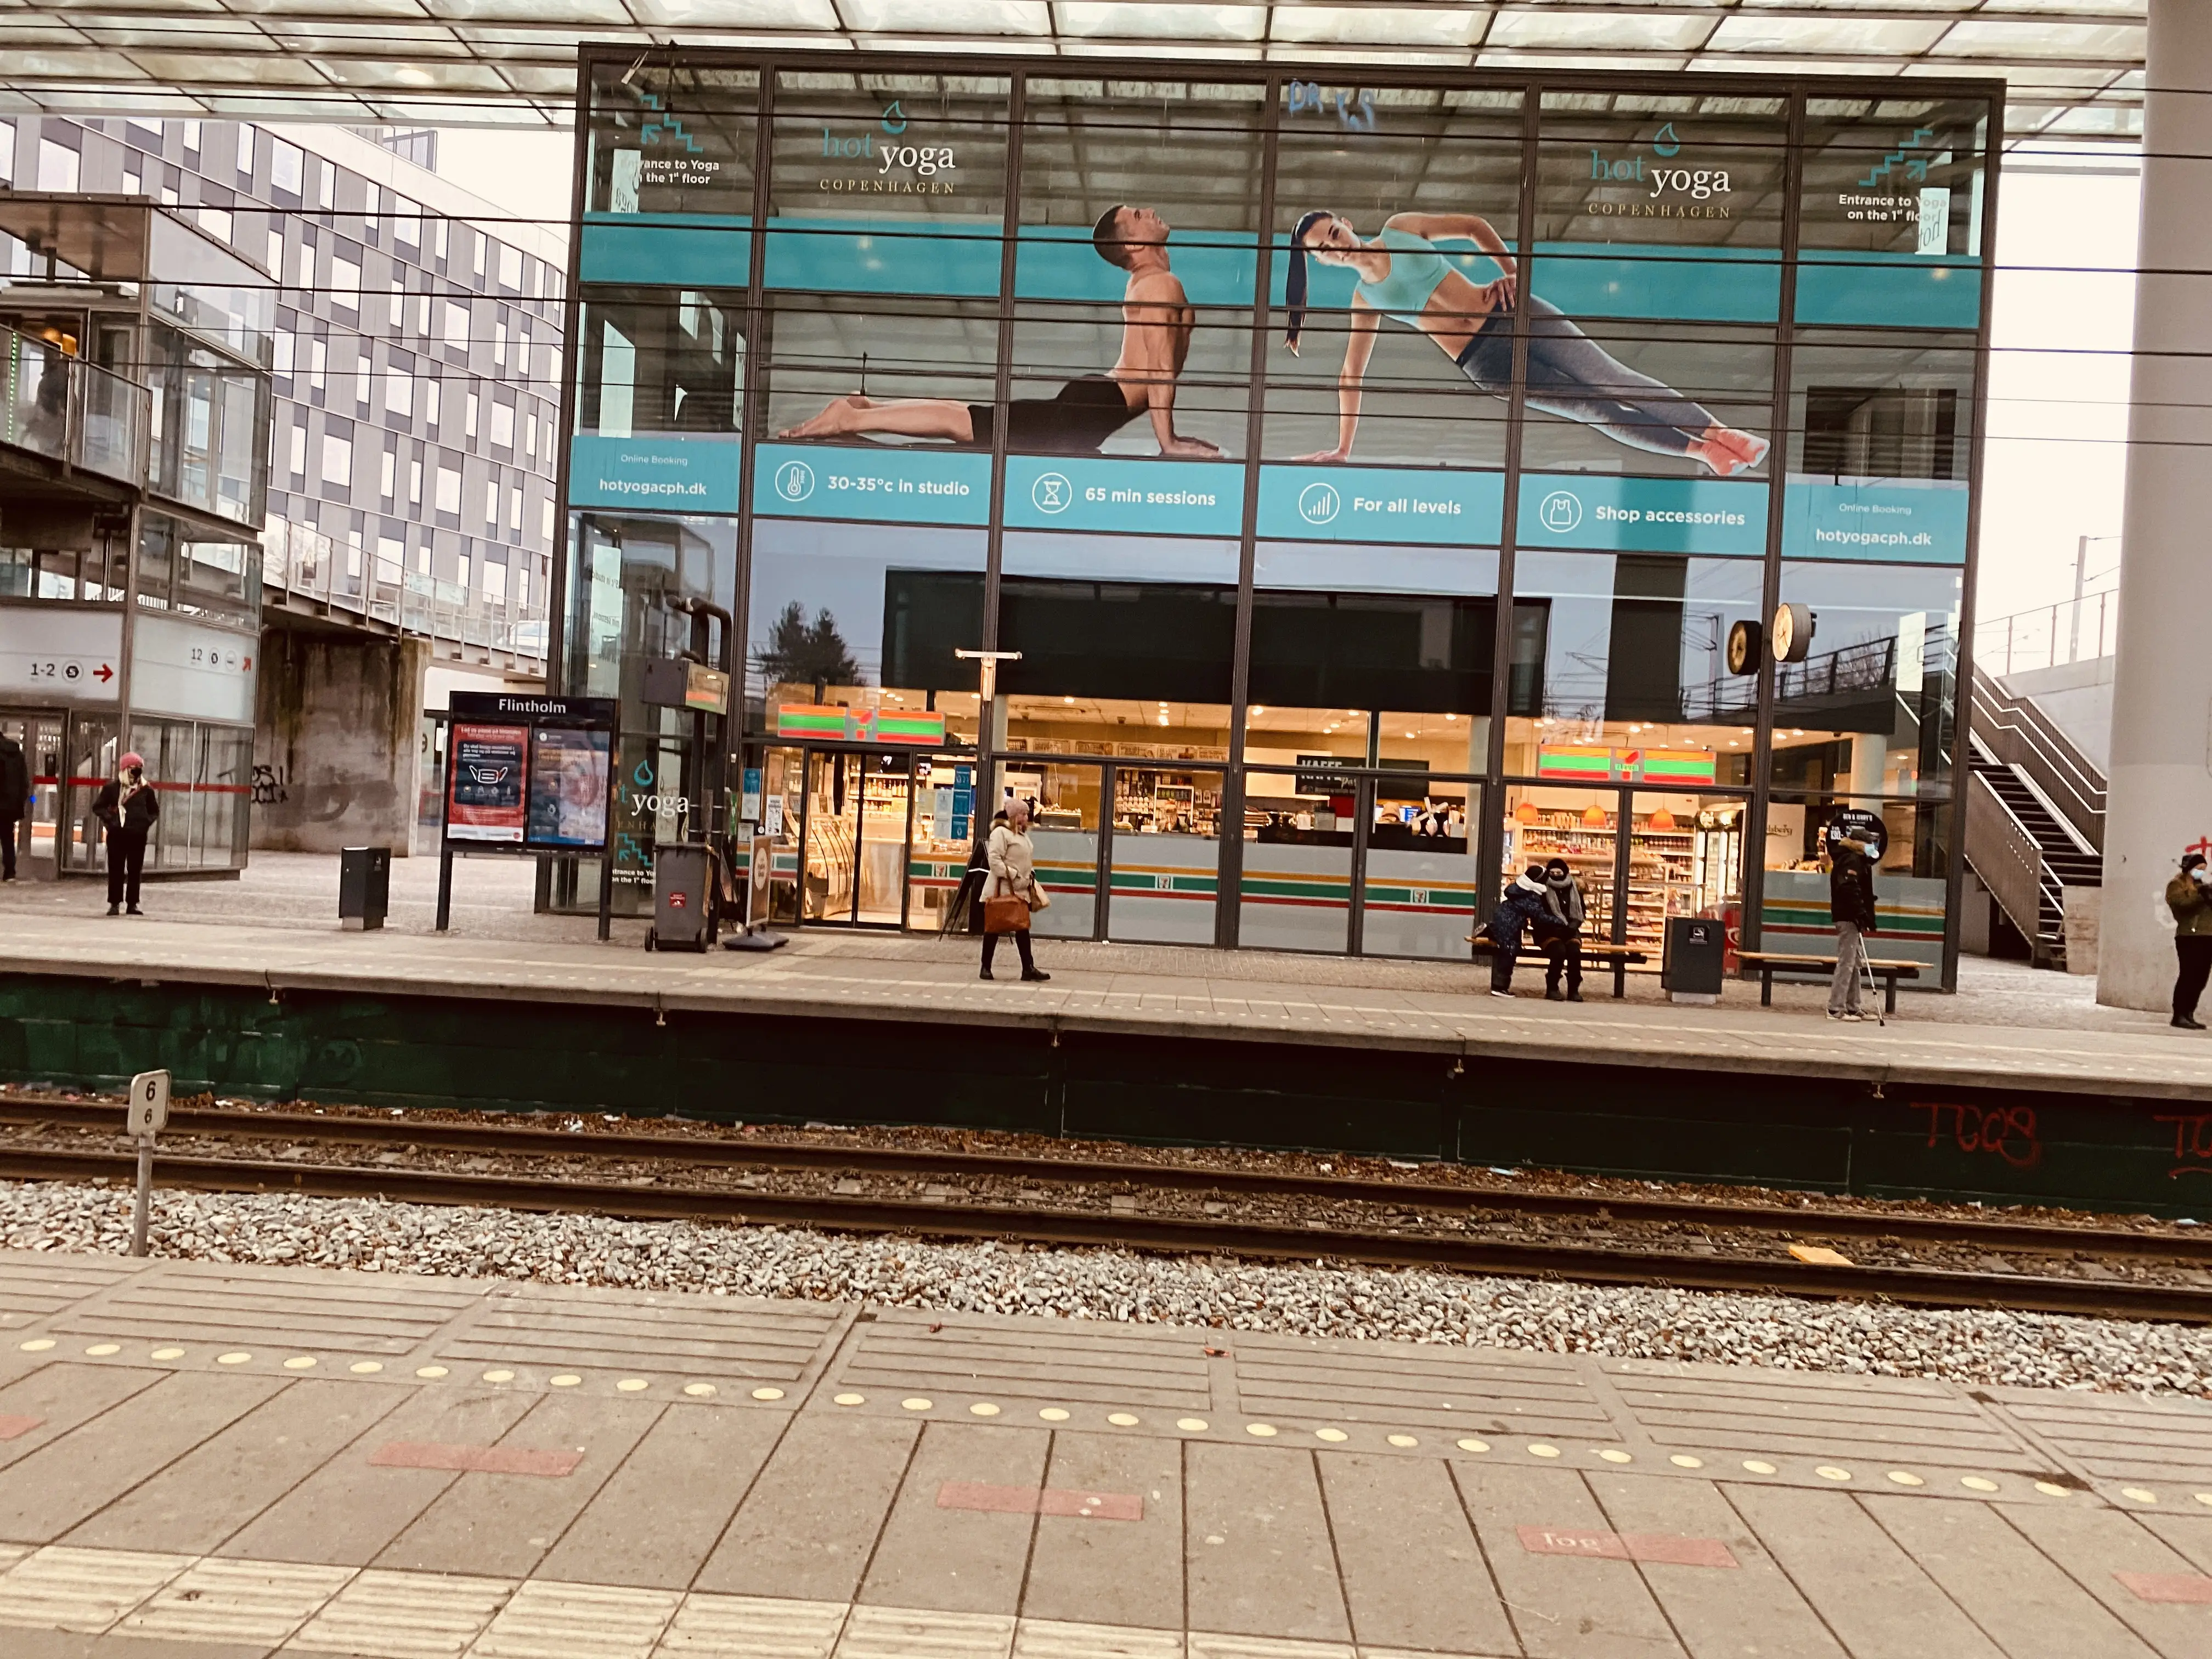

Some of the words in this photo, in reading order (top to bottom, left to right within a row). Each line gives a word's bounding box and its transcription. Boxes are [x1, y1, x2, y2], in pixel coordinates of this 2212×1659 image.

[821, 127, 874, 158] hot
[879, 145, 956, 175] yoga
[675, 160, 686, 170] to
[691, 160, 719, 172] Yoga
[1590, 149, 1646, 182] hot
[1650, 169, 1731, 199] yoga
[646, 172, 665, 183] the
[682, 173, 710, 184] floor
[820, 179, 955, 194] COPENHAGEN
[1839, 194, 1894, 206] Entrance
[1898, 196, 1911, 207] to
[1588, 202, 1730, 218] COPENHAGEN
[1847, 210, 1863, 219] on
[1867, 210, 1888, 221] the
[621, 454, 649, 464] Online
[651, 455, 688, 466] Booking
[600, 478, 707, 495] hotyogacph.dk
[899, 478, 913, 493] in
[918, 480, 970, 495] studio
[1085, 488, 1106, 501] 65
[1111, 488, 1142, 503] min
[1147, 490, 1216, 506] sessions
[1353, 497, 1383, 512] For
[1387, 499, 1407, 514] all
[1413, 499, 1462, 515] levels
[1839, 503, 1870, 512] Online
[1872, 505, 1912, 516] Booking
[1596, 506, 1640, 523] Shop
[1646, 510, 1746, 525] accessories
[1816, 528, 1932, 546] hotyogacph.dk
[30, 663, 55, 676] 1-2
[499, 698, 566, 714] Flintholm
[631, 794, 689, 817] yoga
[146, 1080, 156, 1102] 6
[144, 1108, 153, 1125] 6
